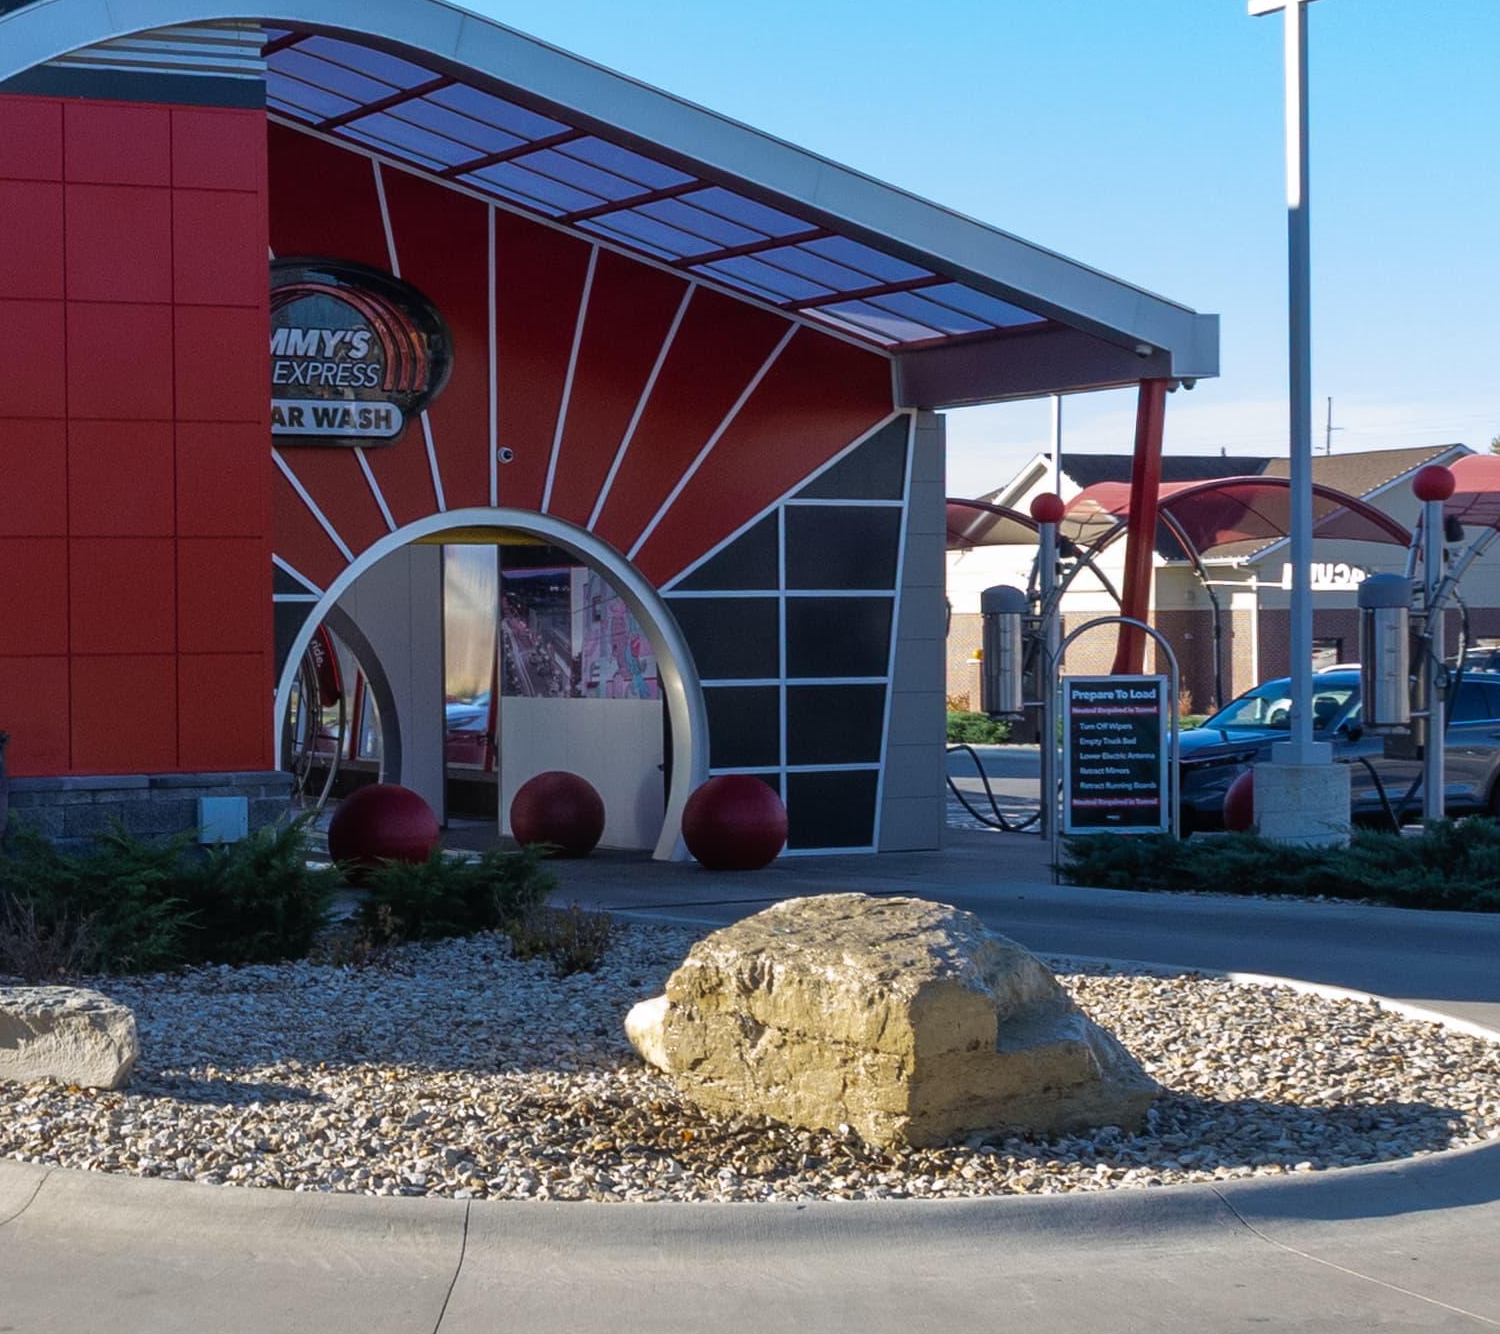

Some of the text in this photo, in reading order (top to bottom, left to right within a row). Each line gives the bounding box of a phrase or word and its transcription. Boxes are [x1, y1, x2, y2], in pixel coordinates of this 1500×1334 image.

[272, 361, 380, 387] EXPRESS
[311, 407, 392, 430] WASH
[1072, 689, 1156, 702] Prepare To Load
[1097, 707, 1128, 715] Required
[1109, 723, 1133, 731] Wipers
[1080, 737, 1102, 746] Empty
[1105, 782, 1133, 790] Running
[1098, 798, 1128, 806] Required
